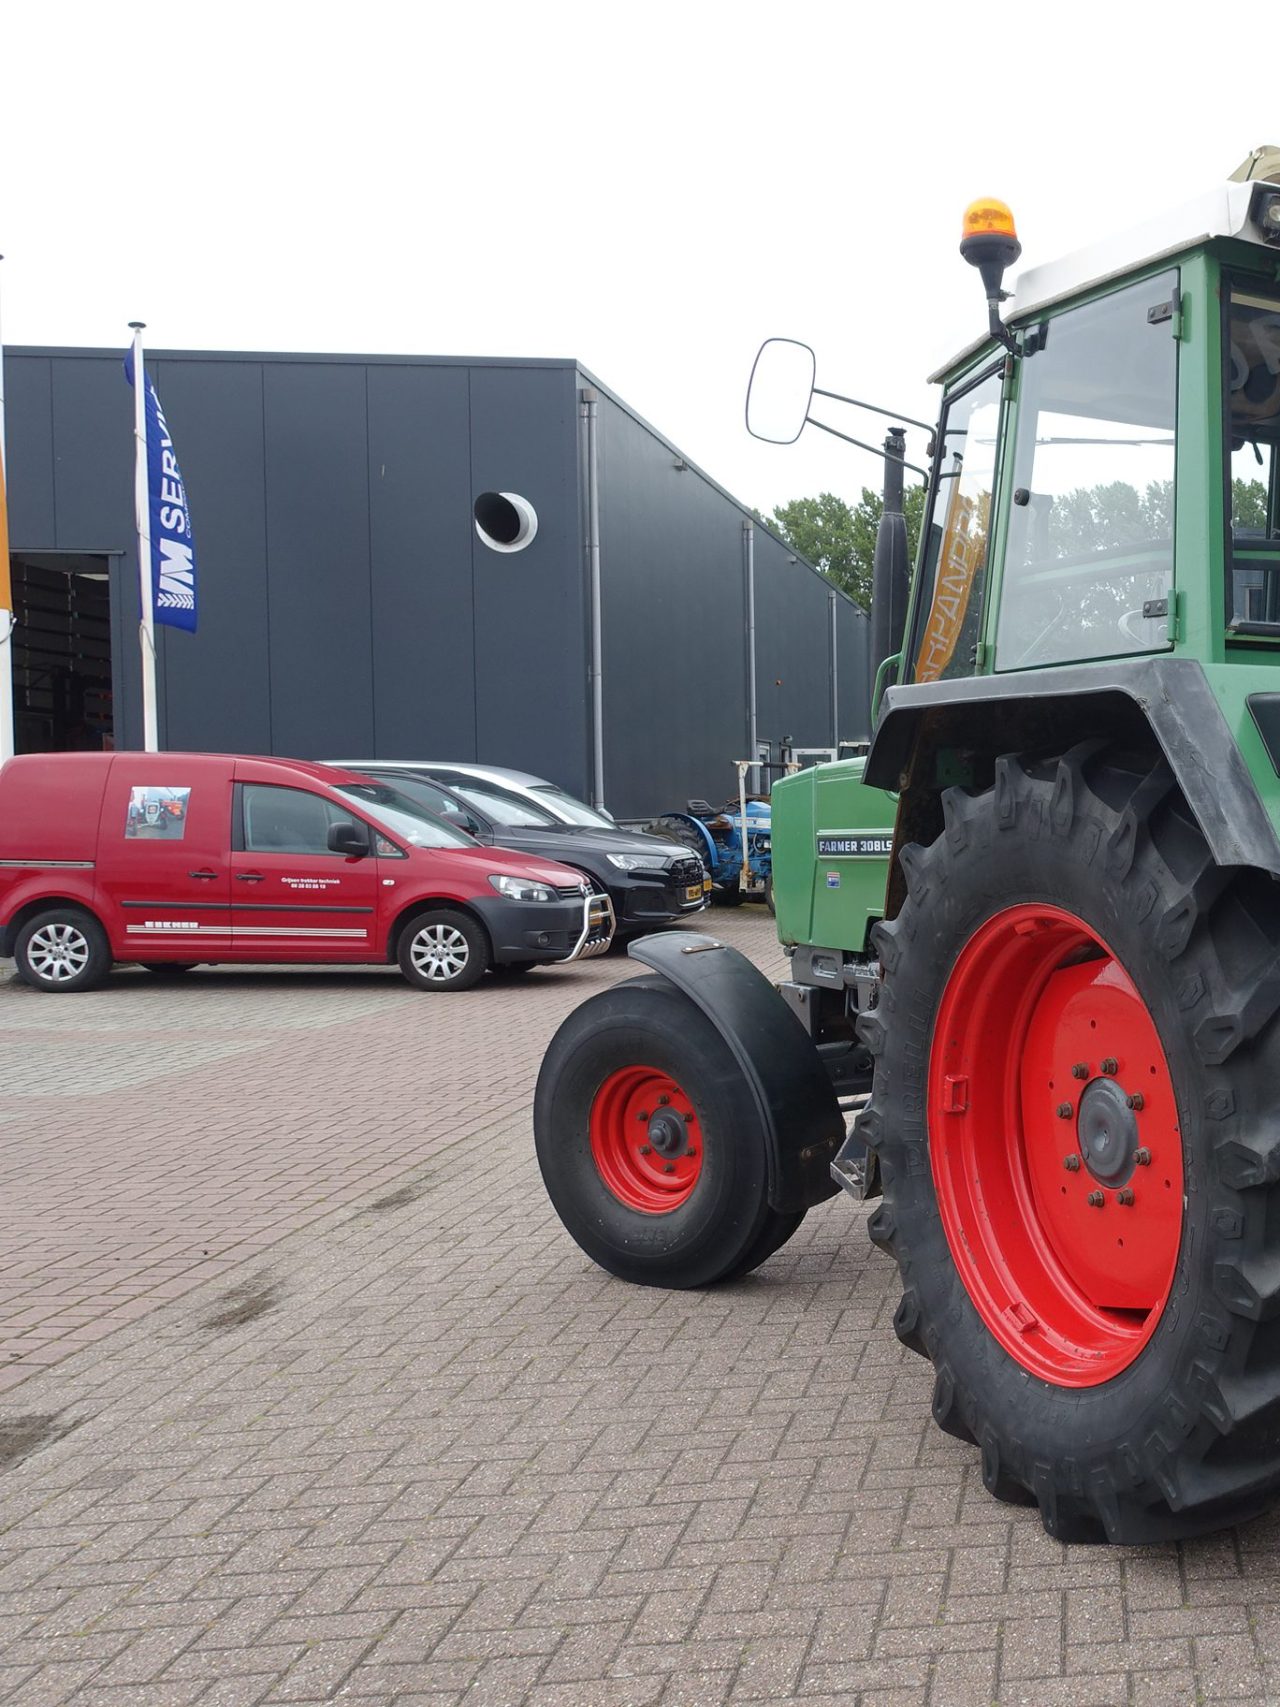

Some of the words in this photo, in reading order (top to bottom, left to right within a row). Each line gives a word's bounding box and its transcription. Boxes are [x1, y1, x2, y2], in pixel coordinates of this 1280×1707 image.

[819, 840, 858, 852] FARMER
[860, 840, 893, 852] 308LS
[902, 986, 936, 1178] PIRELLI
